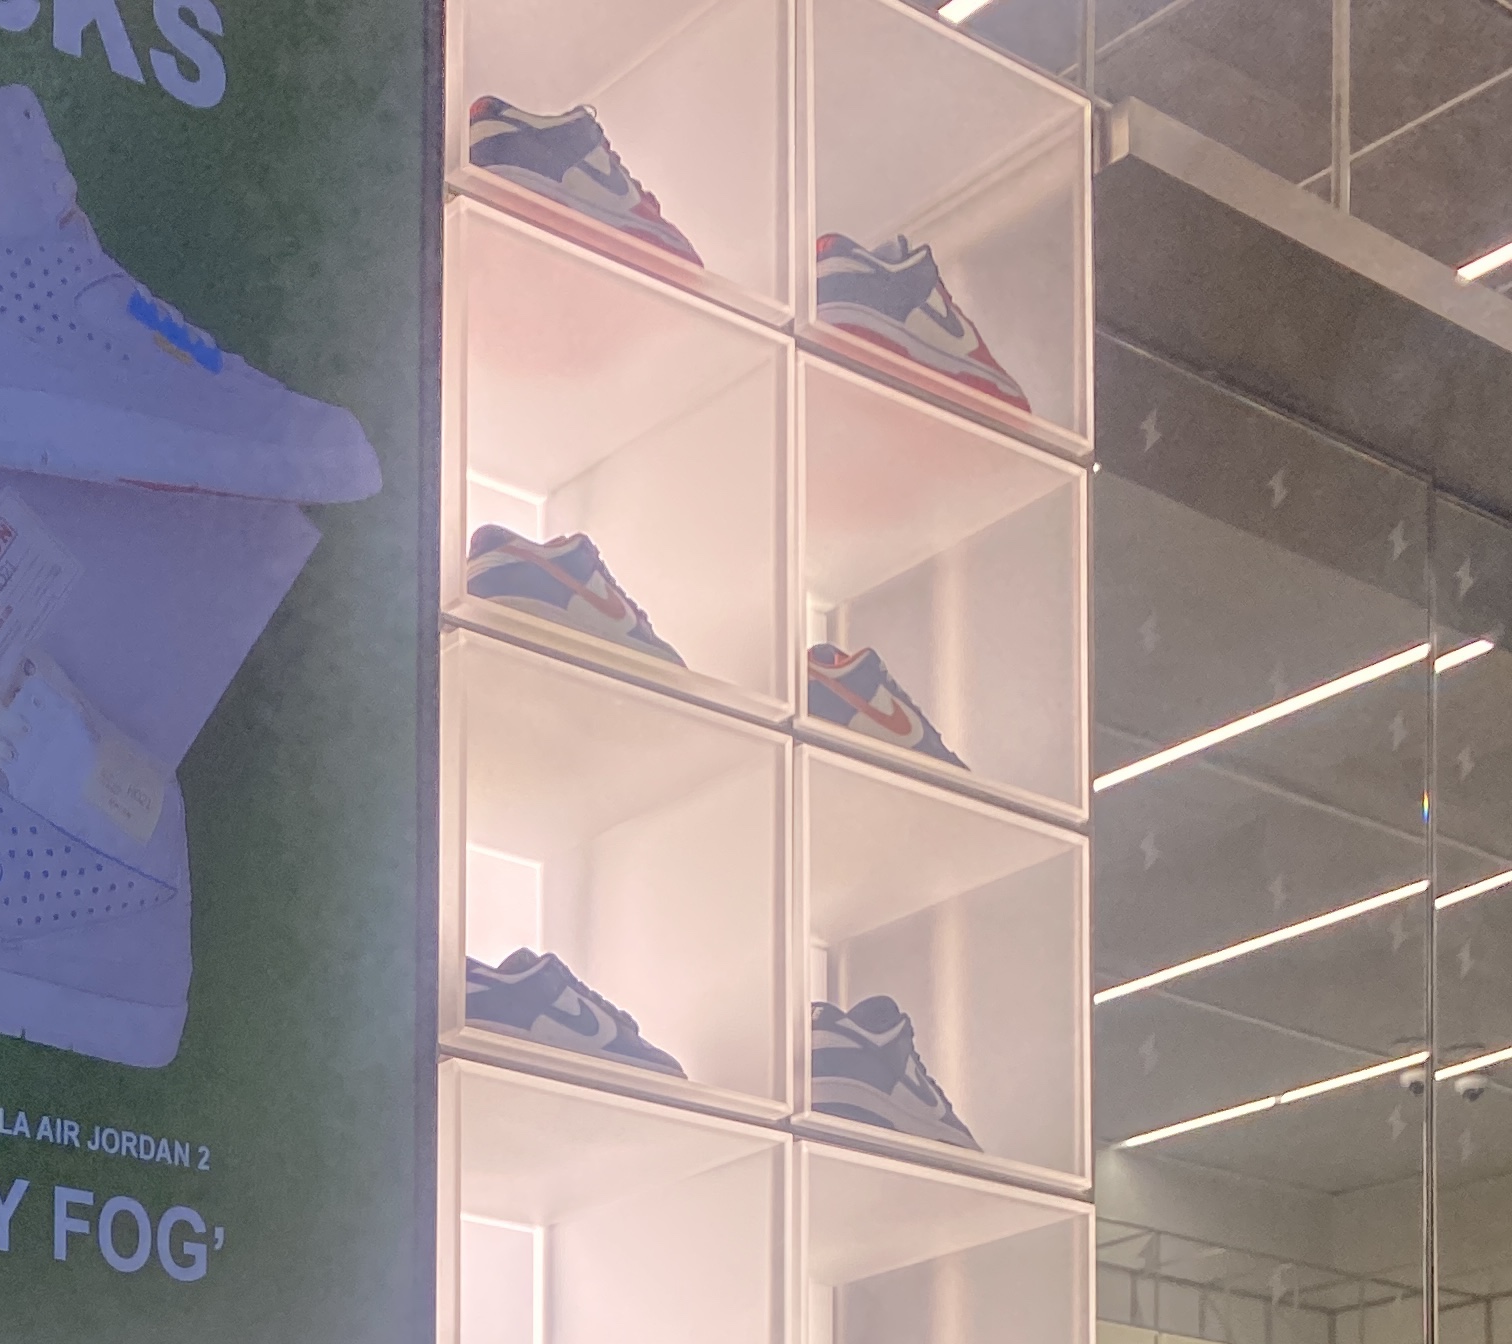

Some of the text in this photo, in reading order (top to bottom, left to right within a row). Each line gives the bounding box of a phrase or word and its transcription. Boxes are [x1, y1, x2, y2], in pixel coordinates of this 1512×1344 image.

[35, 1115, 81, 1147] AIR
[88, 1125, 190, 1167] JORDAN
[197, 1145, 211, 1171] 2
